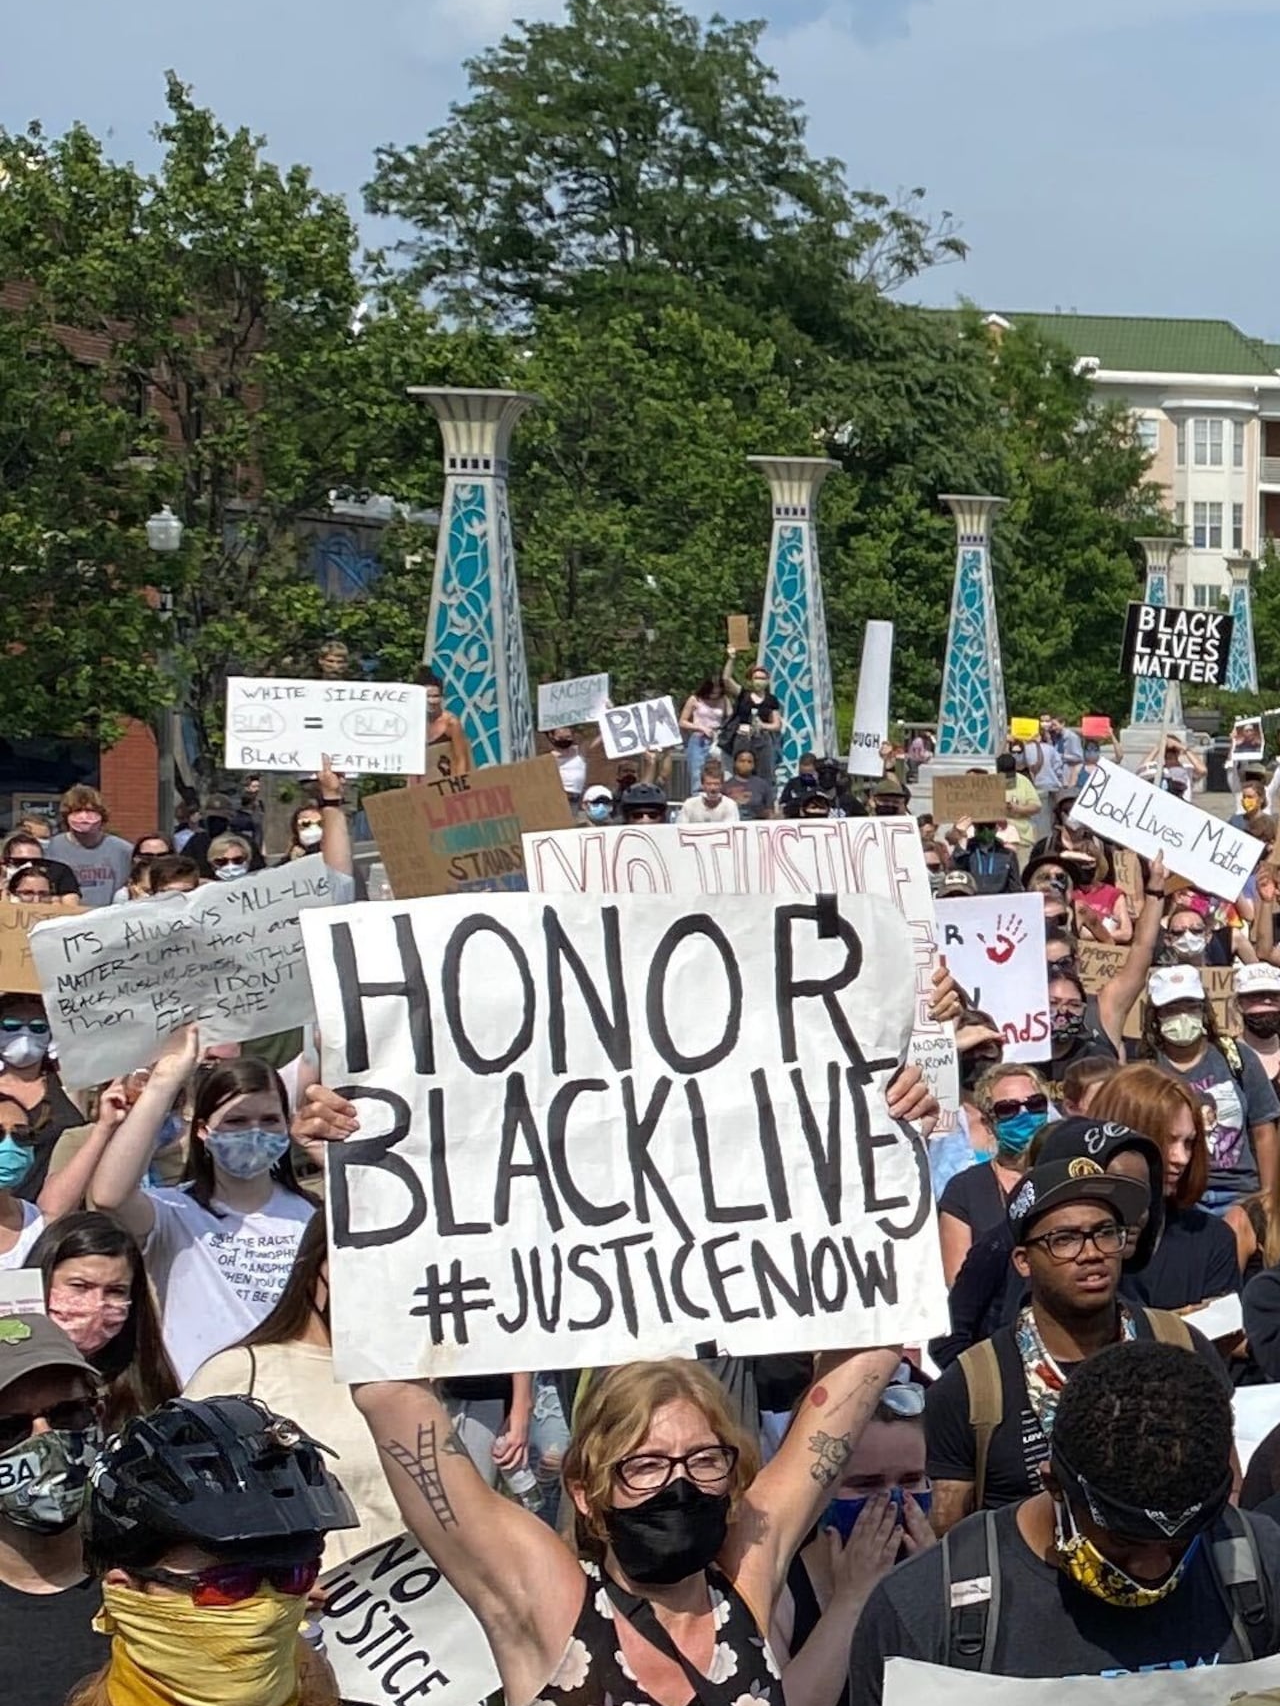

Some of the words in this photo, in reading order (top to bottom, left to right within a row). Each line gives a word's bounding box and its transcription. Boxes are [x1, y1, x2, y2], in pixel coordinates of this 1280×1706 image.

[1138, 607, 1221, 640] BLACK
[1135, 631, 1220, 662] LIVES
[1132, 653, 1220, 684] MATTER
[241, 686, 305, 699] WHITE
[323, 686, 409, 702] SILENCE
[354, 714, 400, 733] BLM
[605, 699, 680, 753] BLM
[241, 746, 301, 766] BLACK
[427, 774, 471, 797] THE
[207, 927, 256, 952] they
[330, 901, 899, 1078] HONOR
[411, 1231, 899, 1344] #JUSTICENOW
[351, 1537, 441, 1603] NO
